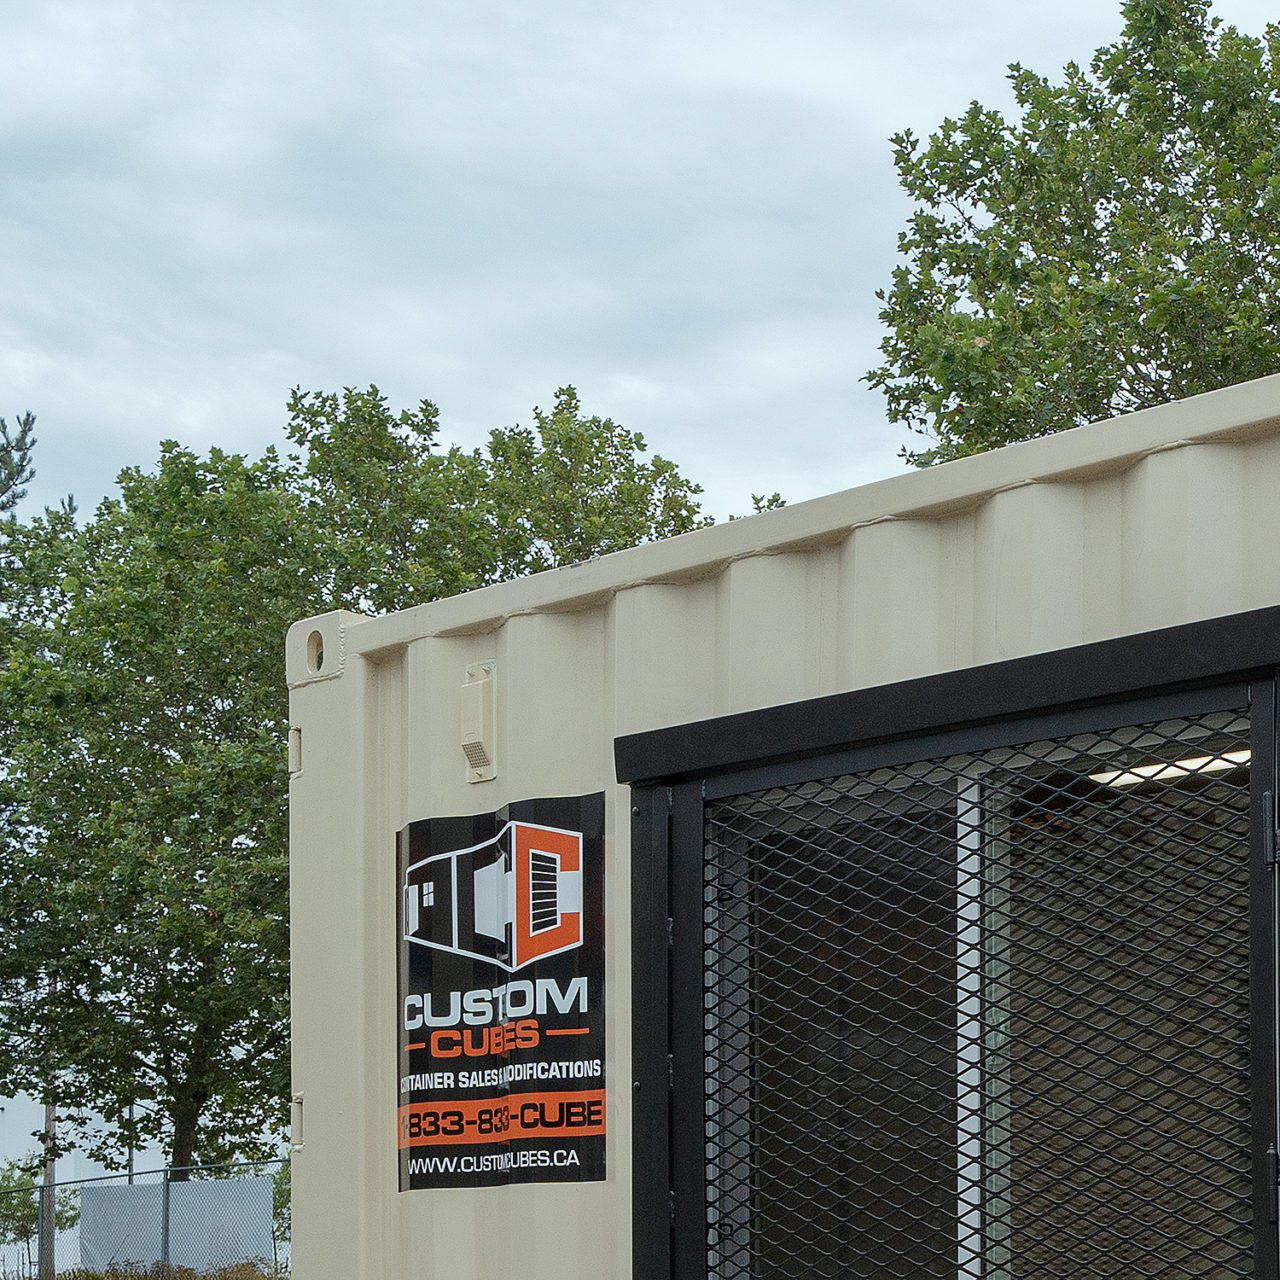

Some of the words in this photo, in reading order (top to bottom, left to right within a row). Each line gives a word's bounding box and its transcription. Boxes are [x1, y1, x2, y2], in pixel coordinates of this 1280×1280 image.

[404, 977, 588, 1030] CUSTOM
[430, 1019, 540, 1059] CUBES
[458, 1069, 498, 1089] SALES
